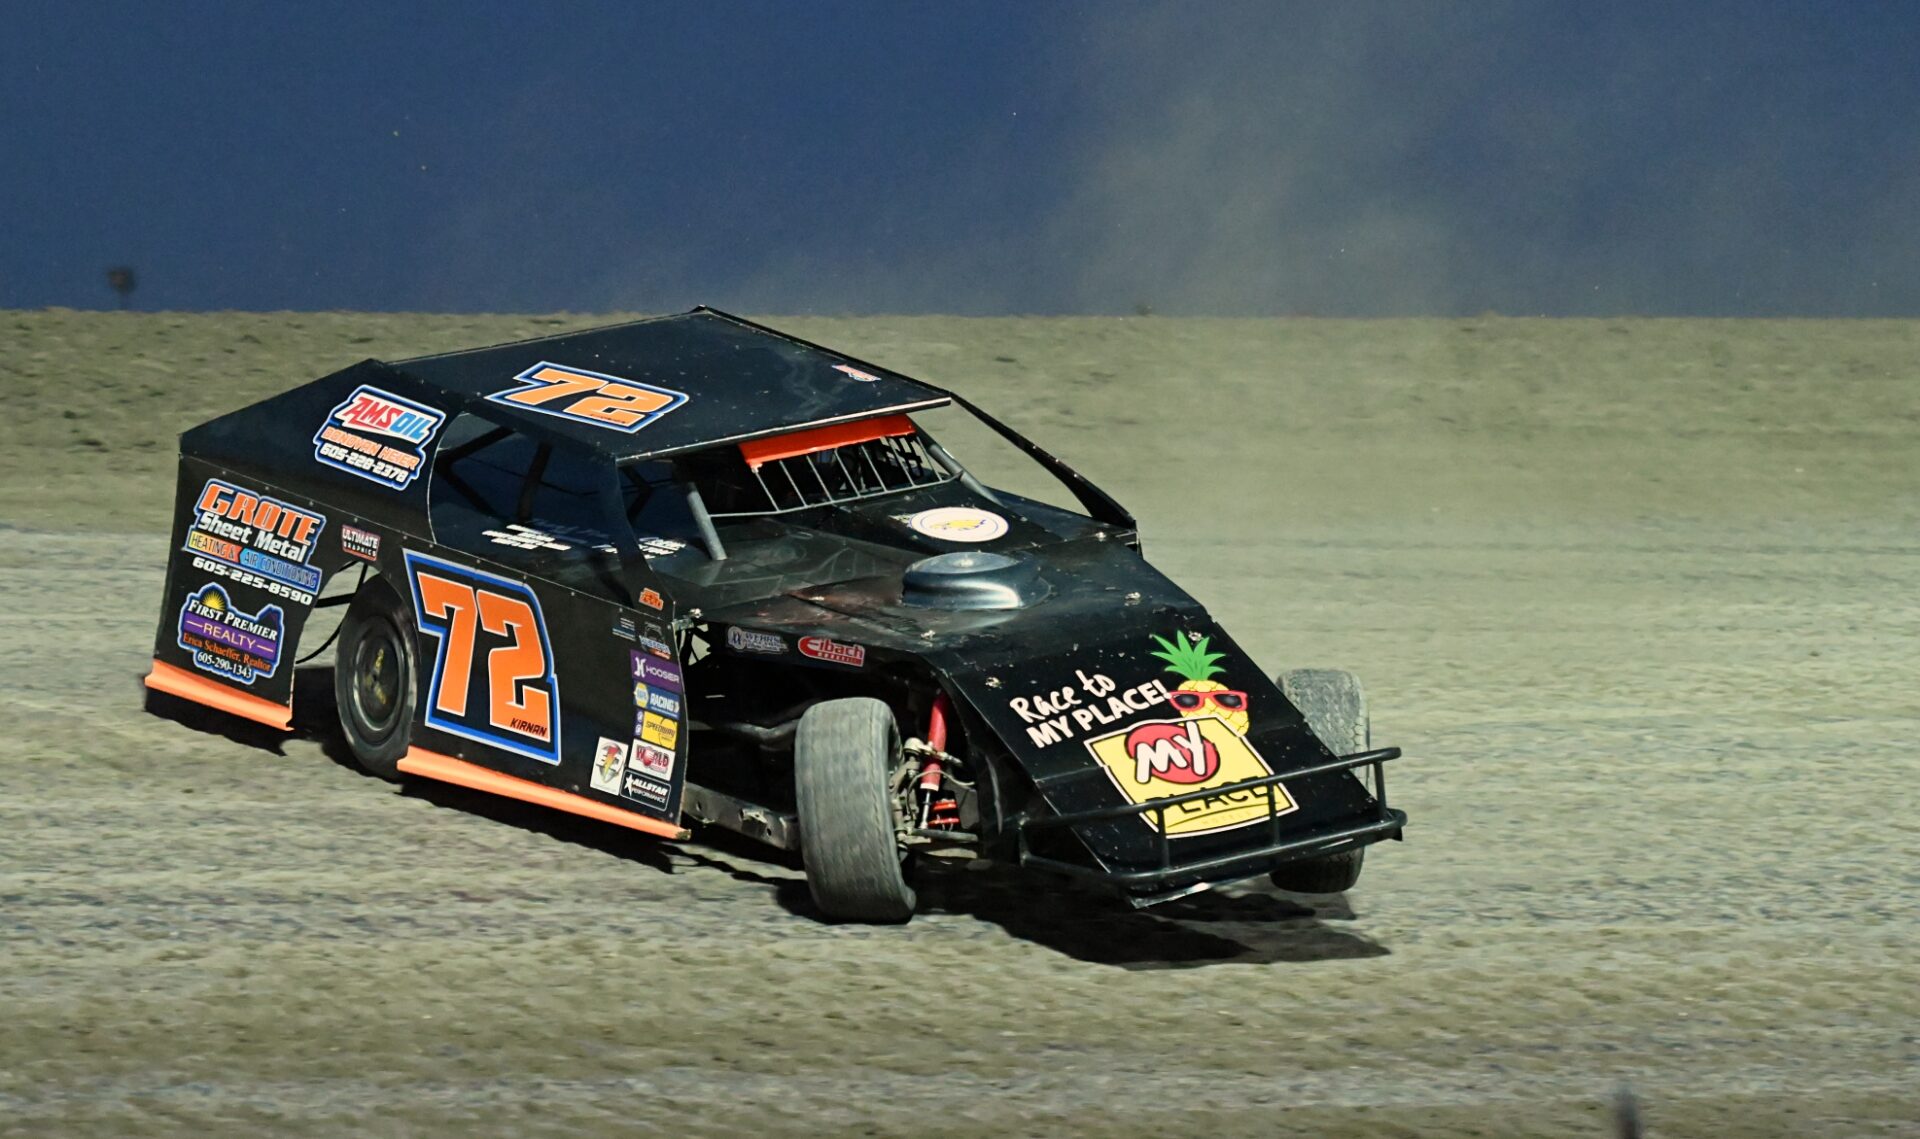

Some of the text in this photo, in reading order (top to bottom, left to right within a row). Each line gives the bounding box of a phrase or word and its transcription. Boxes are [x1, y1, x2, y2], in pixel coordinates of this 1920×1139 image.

[341, 396, 432, 441] AMSOIL
[504, 367, 674, 427] 72
[199, 483, 320, 546] GROTE
[198, 511, 307, 562] Sheet Metal
[342, 527, 378, 549] ULTIMATE
[192, 532, 226, 556] HEATING
[244, 551, 259, 567] AIR
[261, 556, 317, 589] CONDITIONING
[192, 557, 313, 605] 605-225-8590
[187, 599, 277, 641] FIRST PREMIER
[203, 623, 256, 649] REALTY
[183, 632, 203, 647] Erica
[244, 654, 271, 672] Realtor
[197, 651, 252, 678] 605-290-1343
[416, 571, 550, 743] 72
[799, 636, 864, 660] Eibach
[646, 665, 680, 684] HOOSIER
[1009, 669, 1116, 723] Race to
[650, 693, 675, 712] RACING
[1026, 679, 1171, 749] MY PLACE!
[509, 717, 547, 737] KIRNAN
[1135, 720, 1207, 784] MY
[633, 779, 668, 796] ALLSTAR
